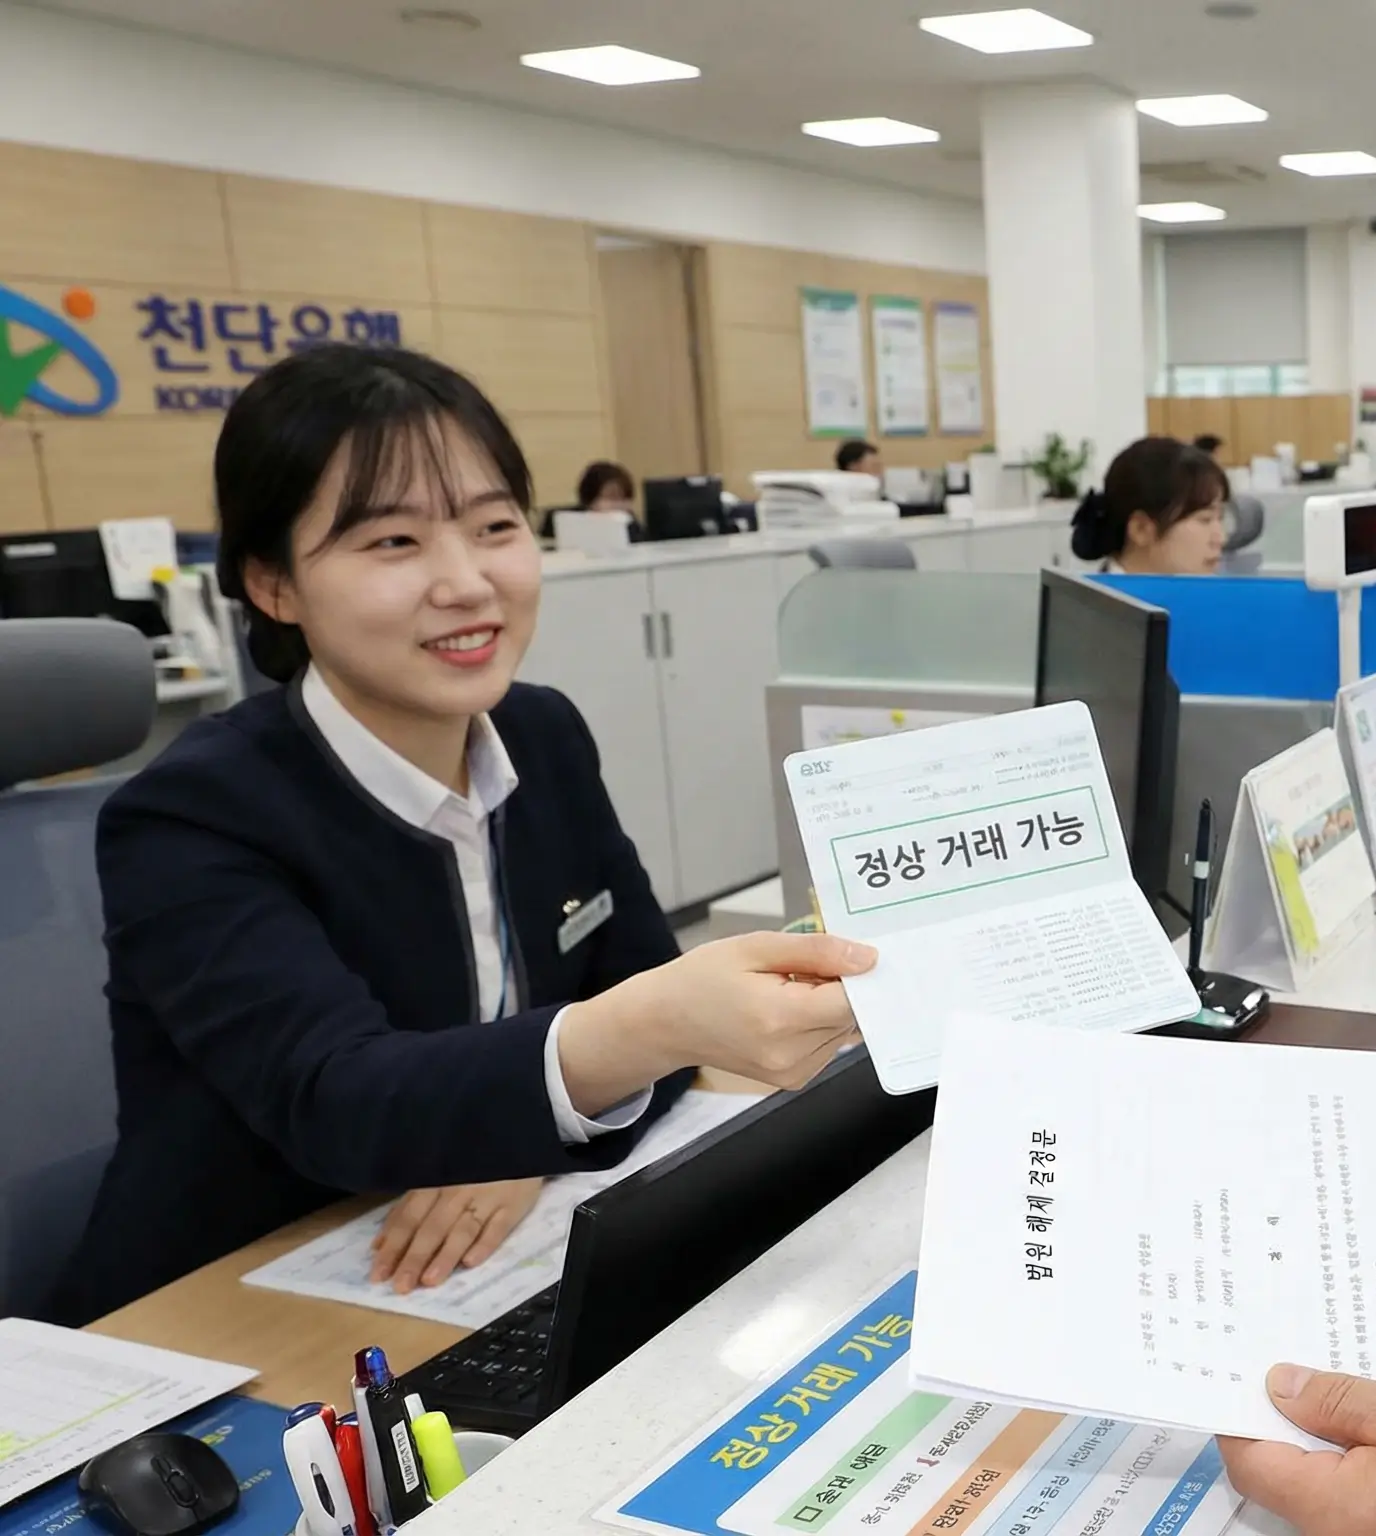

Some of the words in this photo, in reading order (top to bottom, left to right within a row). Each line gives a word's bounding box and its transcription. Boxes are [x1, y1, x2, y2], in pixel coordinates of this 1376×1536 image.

[854, 840, 926, 888] 정상
[937, 823, 1008, 868] 거래
[1016, 811, 1085, 851] 가능
[1025, 1195, 1054, 1233] 해제
[1024, 1242, 1054, 1281] 법원
[838, 1314, 912, 1362] 가능
